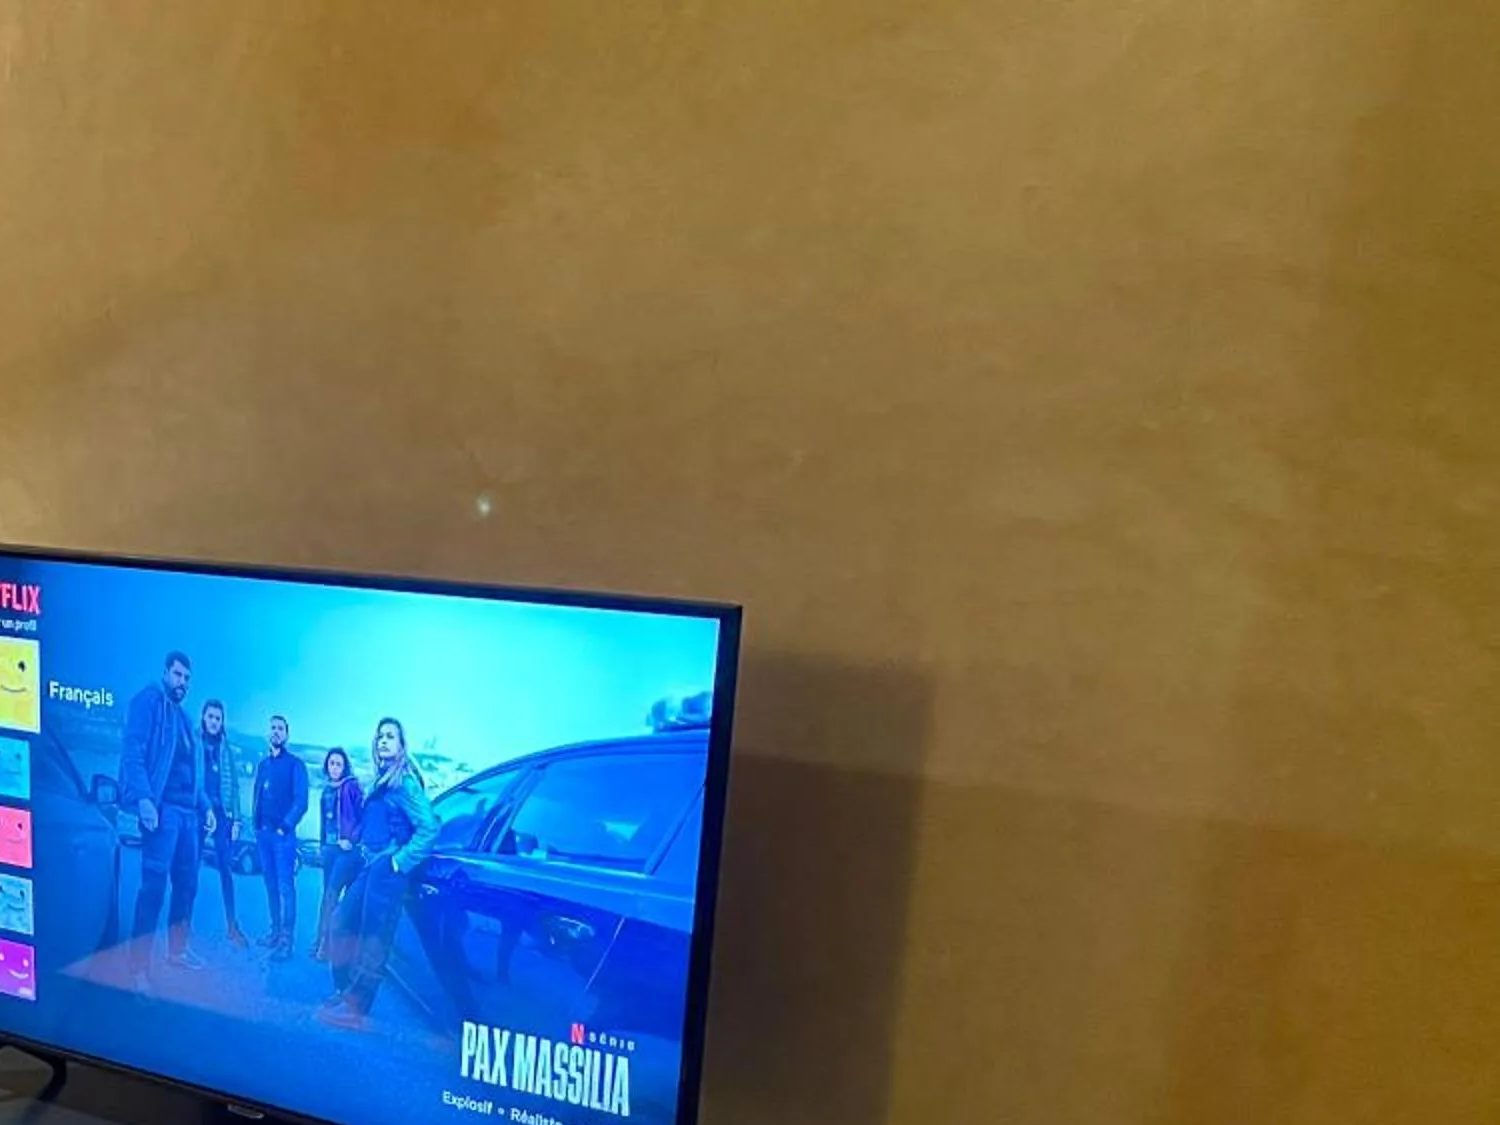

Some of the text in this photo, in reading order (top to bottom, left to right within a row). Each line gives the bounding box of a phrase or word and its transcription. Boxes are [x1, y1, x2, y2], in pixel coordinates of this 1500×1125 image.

[2, 618, 14, 629] un
[14, 618, 37, 631] profil
[49, 681, 114, 709] Français
[571, 1023, 585, 1045] N
[460, 1021, 629, 1117] PAX MASSILIA
[442, 1091, 494, 1116] Explosif
